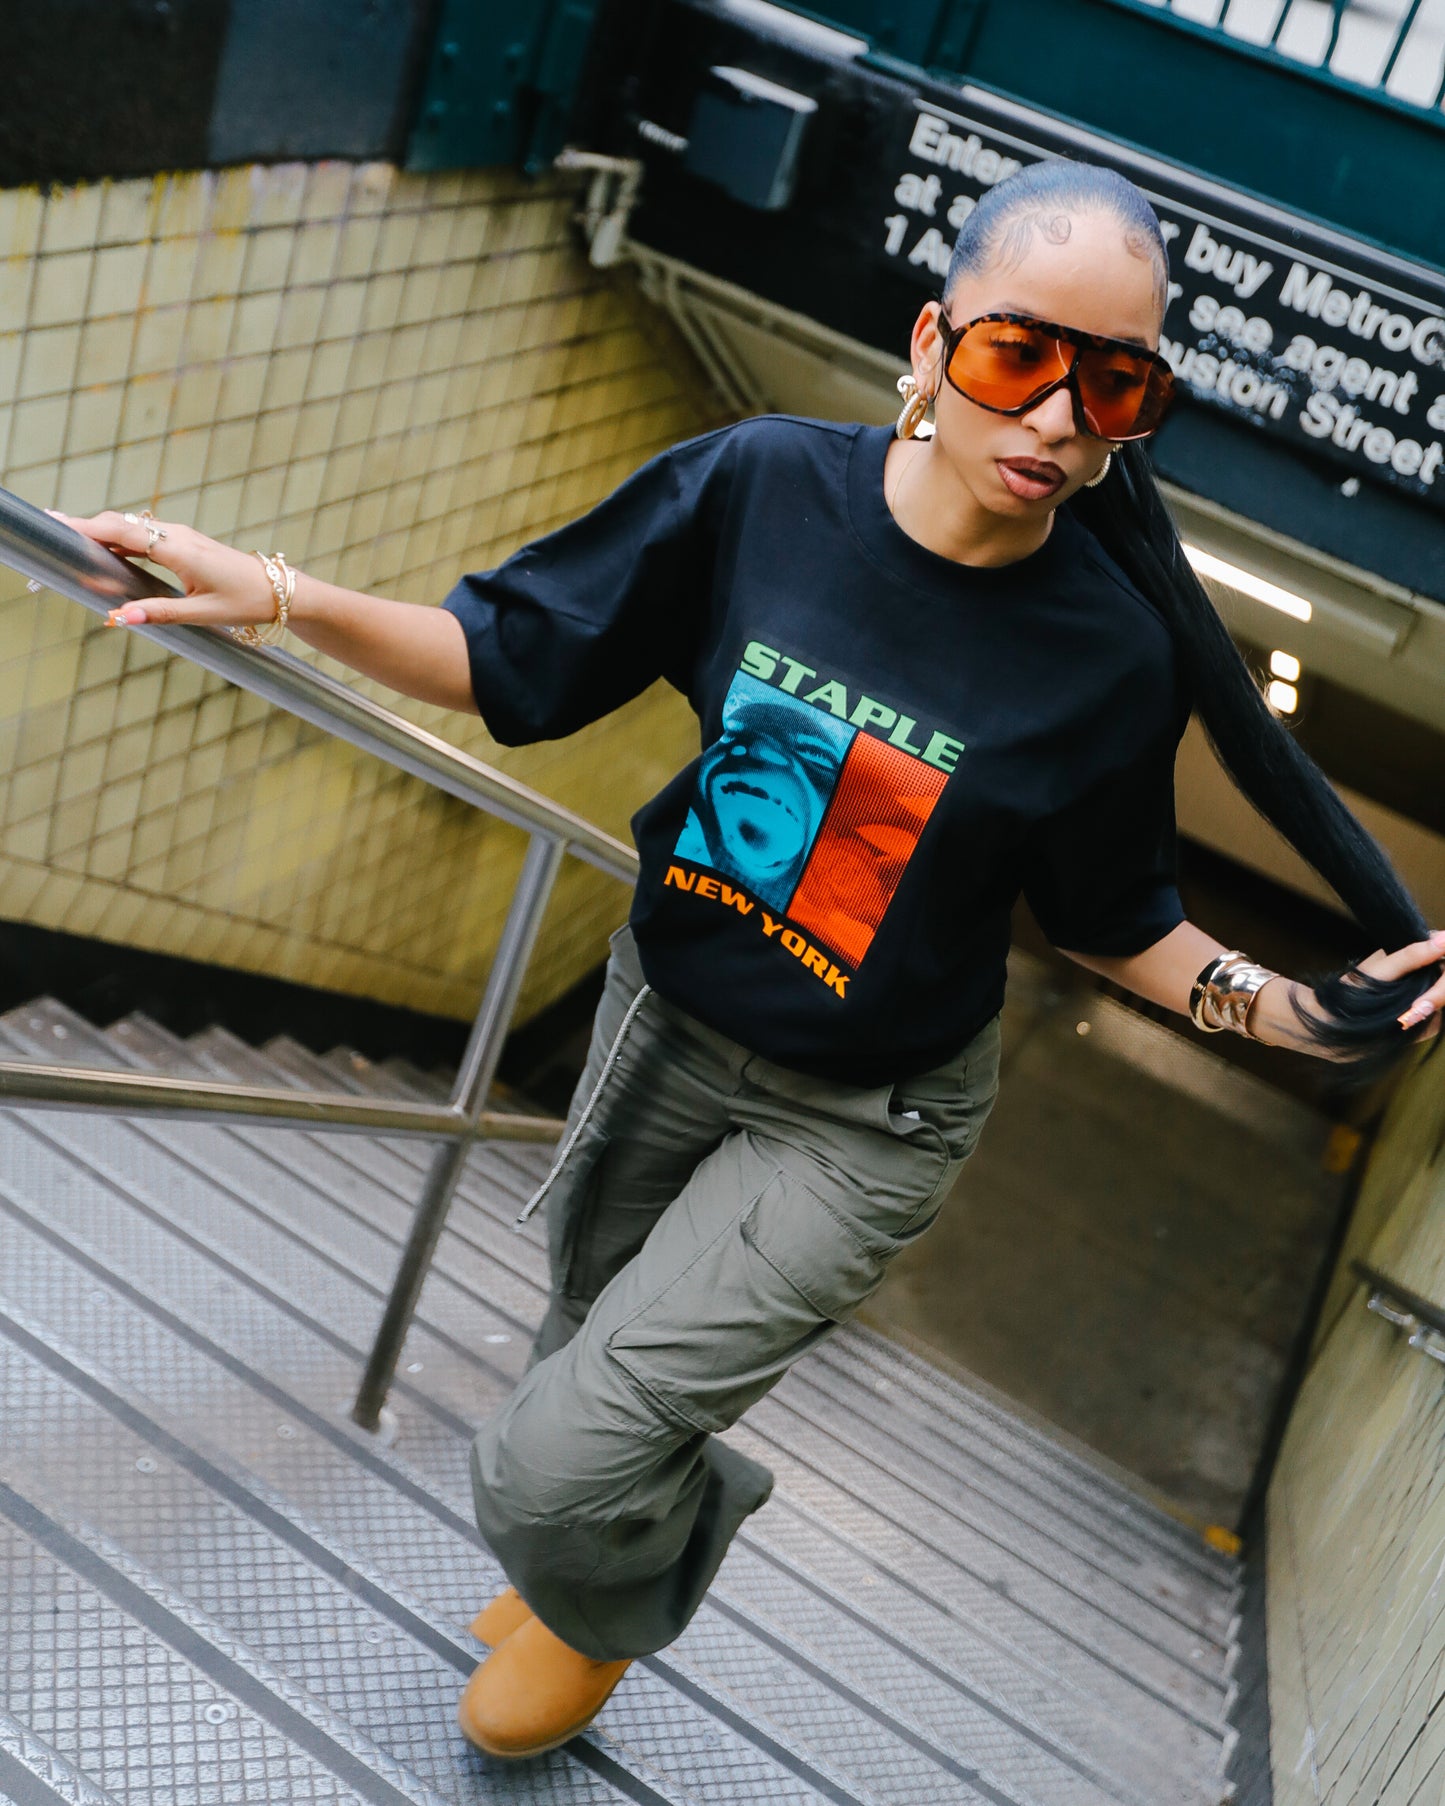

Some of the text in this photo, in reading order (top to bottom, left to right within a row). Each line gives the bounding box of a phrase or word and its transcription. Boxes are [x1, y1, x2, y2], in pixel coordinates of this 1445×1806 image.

[884, 214, 909, 256] 1
[1299, 391, 1444, 484] Street
[894, 173, 943, 217] at
[1189, 295, 1274, 352] see
[1284, 335, 1419, 415] agent
[910, 113, 1022, 185] Enter
[1184, 223, 1274, 298] buy
[1279, 261, 1445, 366] MetroC
[740, 640, 966, 773] STAPLE
[664, 865, 850, 999] NEW YORK
